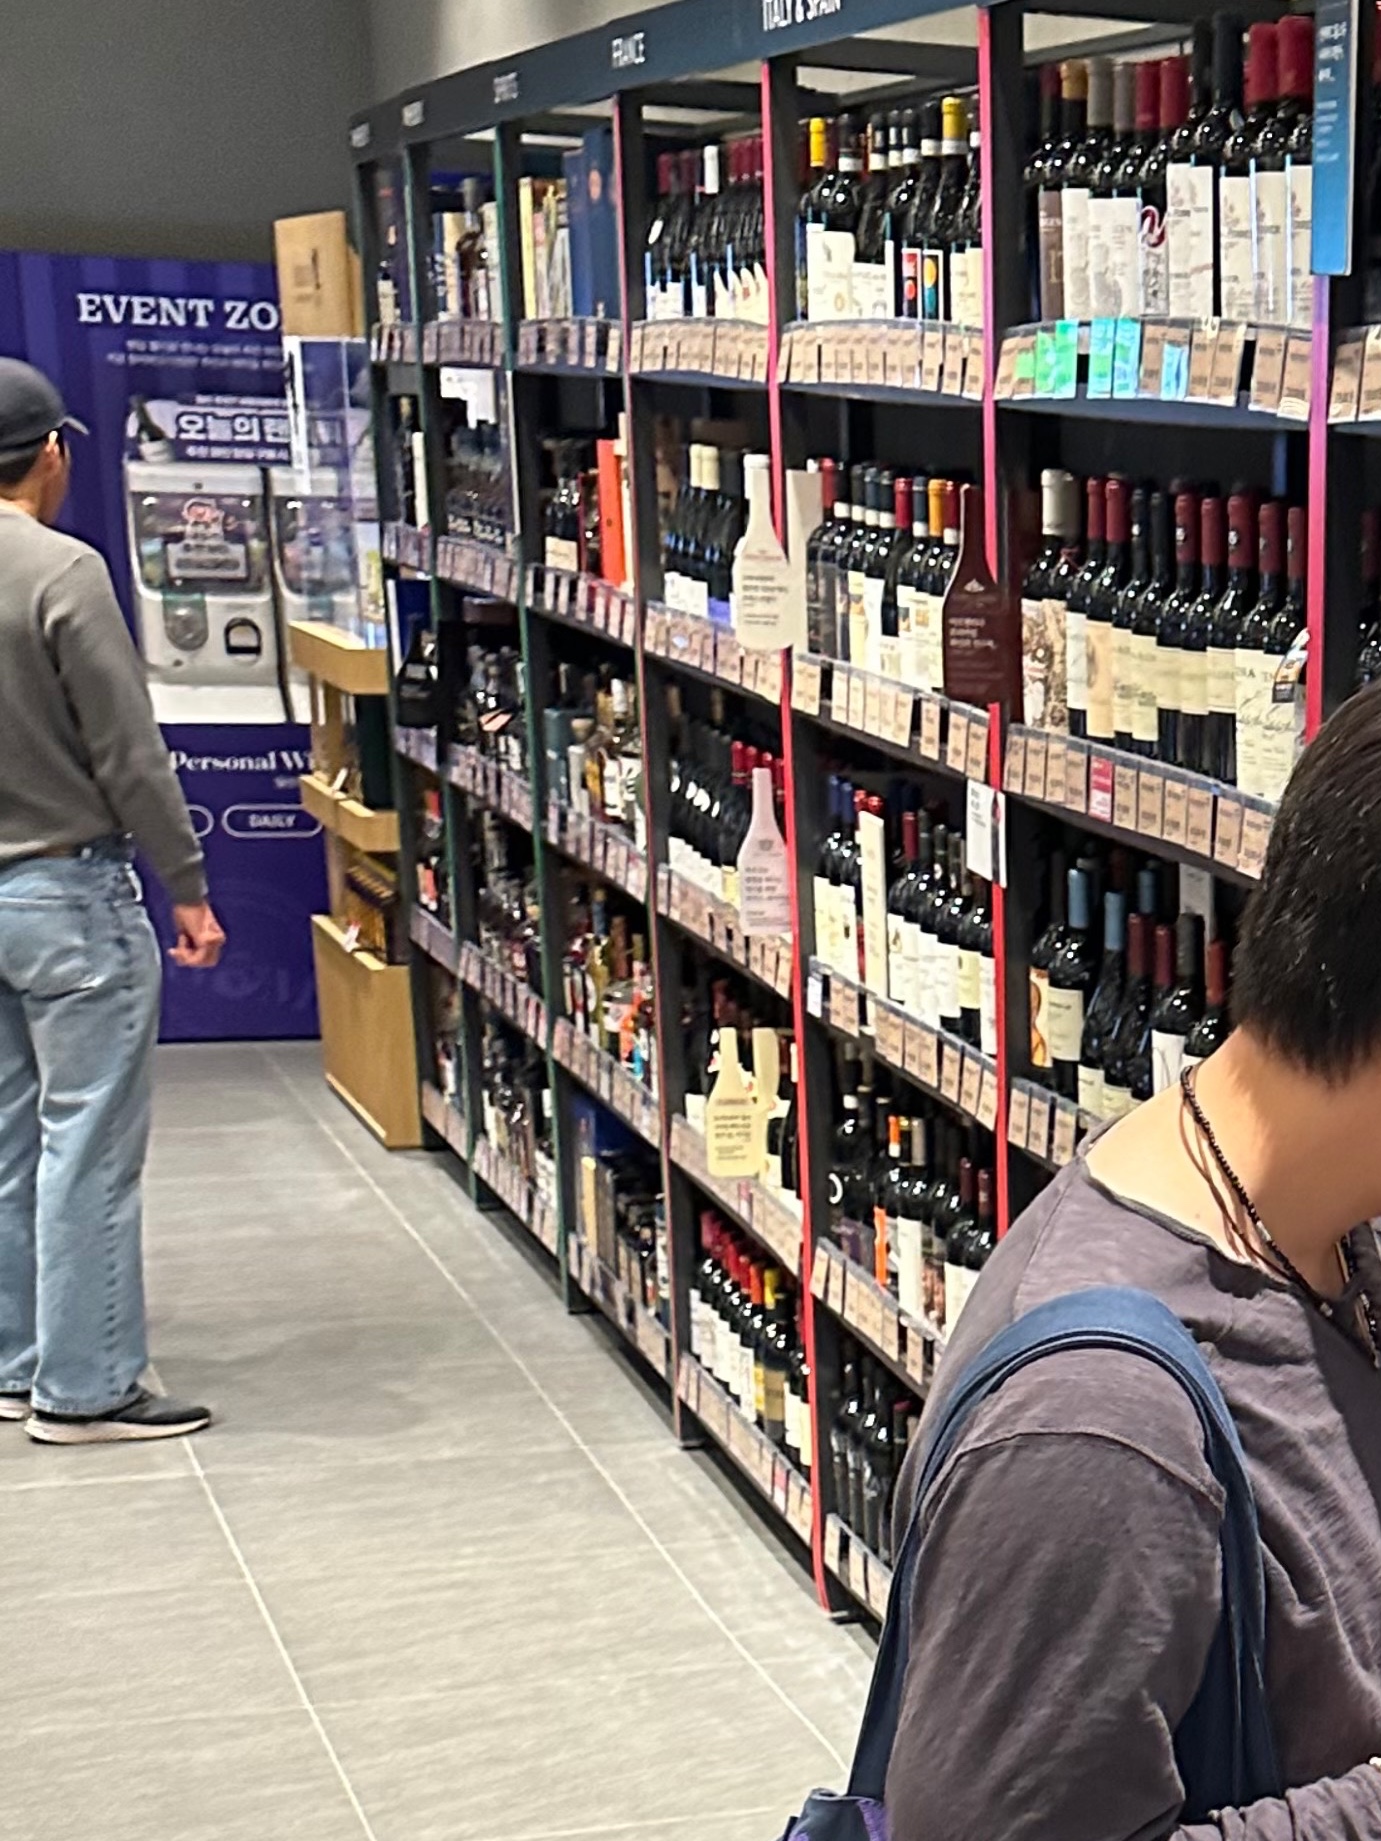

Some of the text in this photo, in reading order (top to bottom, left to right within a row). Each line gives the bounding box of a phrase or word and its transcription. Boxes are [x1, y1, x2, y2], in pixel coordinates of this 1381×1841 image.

[77, 293, 215, 328] EVENT
[169, 750, 276, 771] Personal
[249, 814, 296, 828] DAILY
